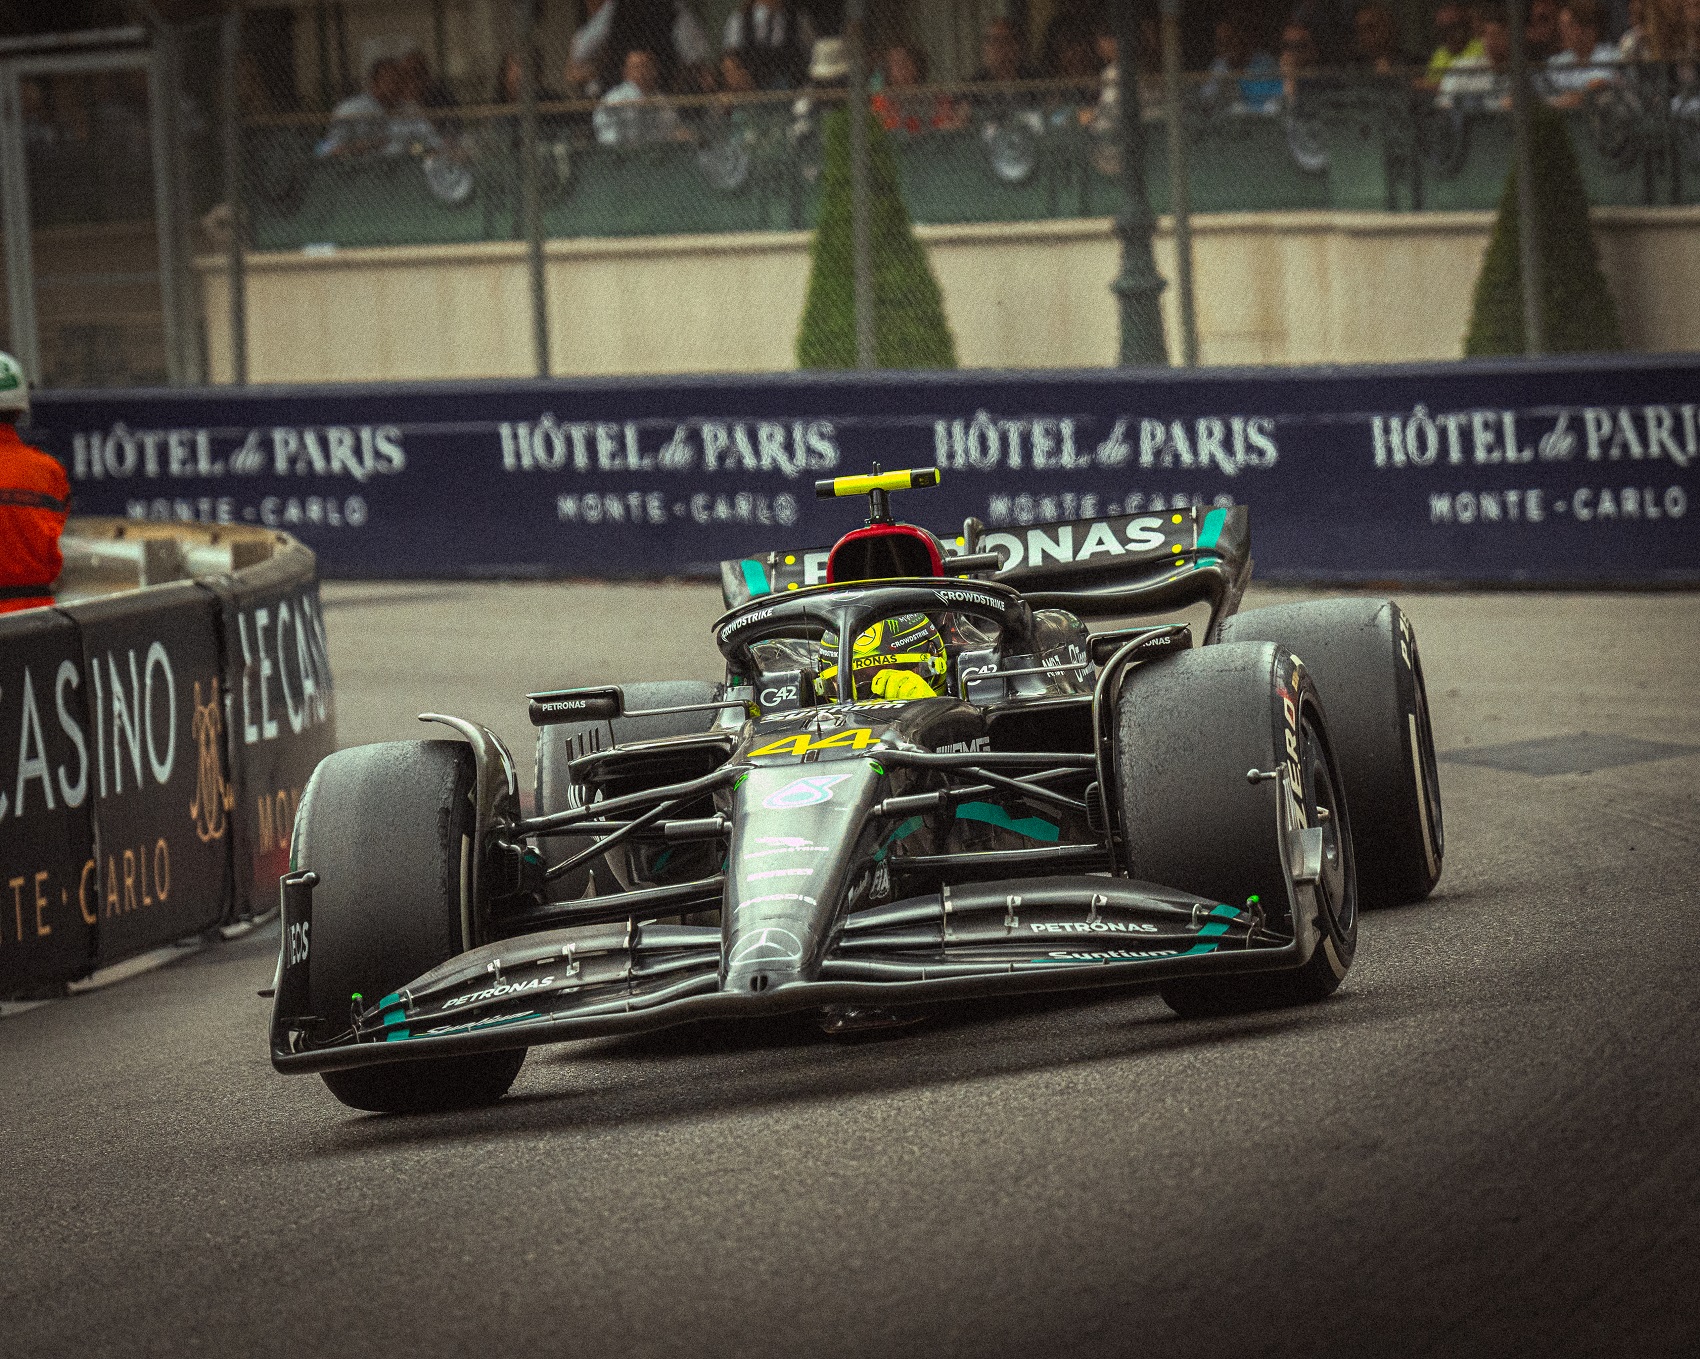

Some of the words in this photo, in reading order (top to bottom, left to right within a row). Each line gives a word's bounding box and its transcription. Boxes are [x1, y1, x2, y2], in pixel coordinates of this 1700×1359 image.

[72, 421, 226, 480] HÔTEL
[270, 424, 407, 482] PARIS
[499, 411, 652, 472] HÔTEL
[701, 420, 840, 479] PARIS
[934, 408, 1091, 470] HÔTEL
[1138, 415, 1279, 477] PARIS
[1370, 402, 1535, 468] HÔTEL
[1582, 403, 1700, 468] PARI
[939, 589, 1006, 613] CROWDSTRIKE
[721, 607, 775, 641] CROWDSTRIKE
[852, 653, 898, 669] RONAS
[542, 700, 586, 712] PETRONAS
[760, 686, 797, 707] G42
[0, 641, 176, 820] ASINO
[747, 728, 881, 758] 44
[1030, 921, 1158, 933] PETRONAS
[441, 975, 555, 1010] PETRONAS
